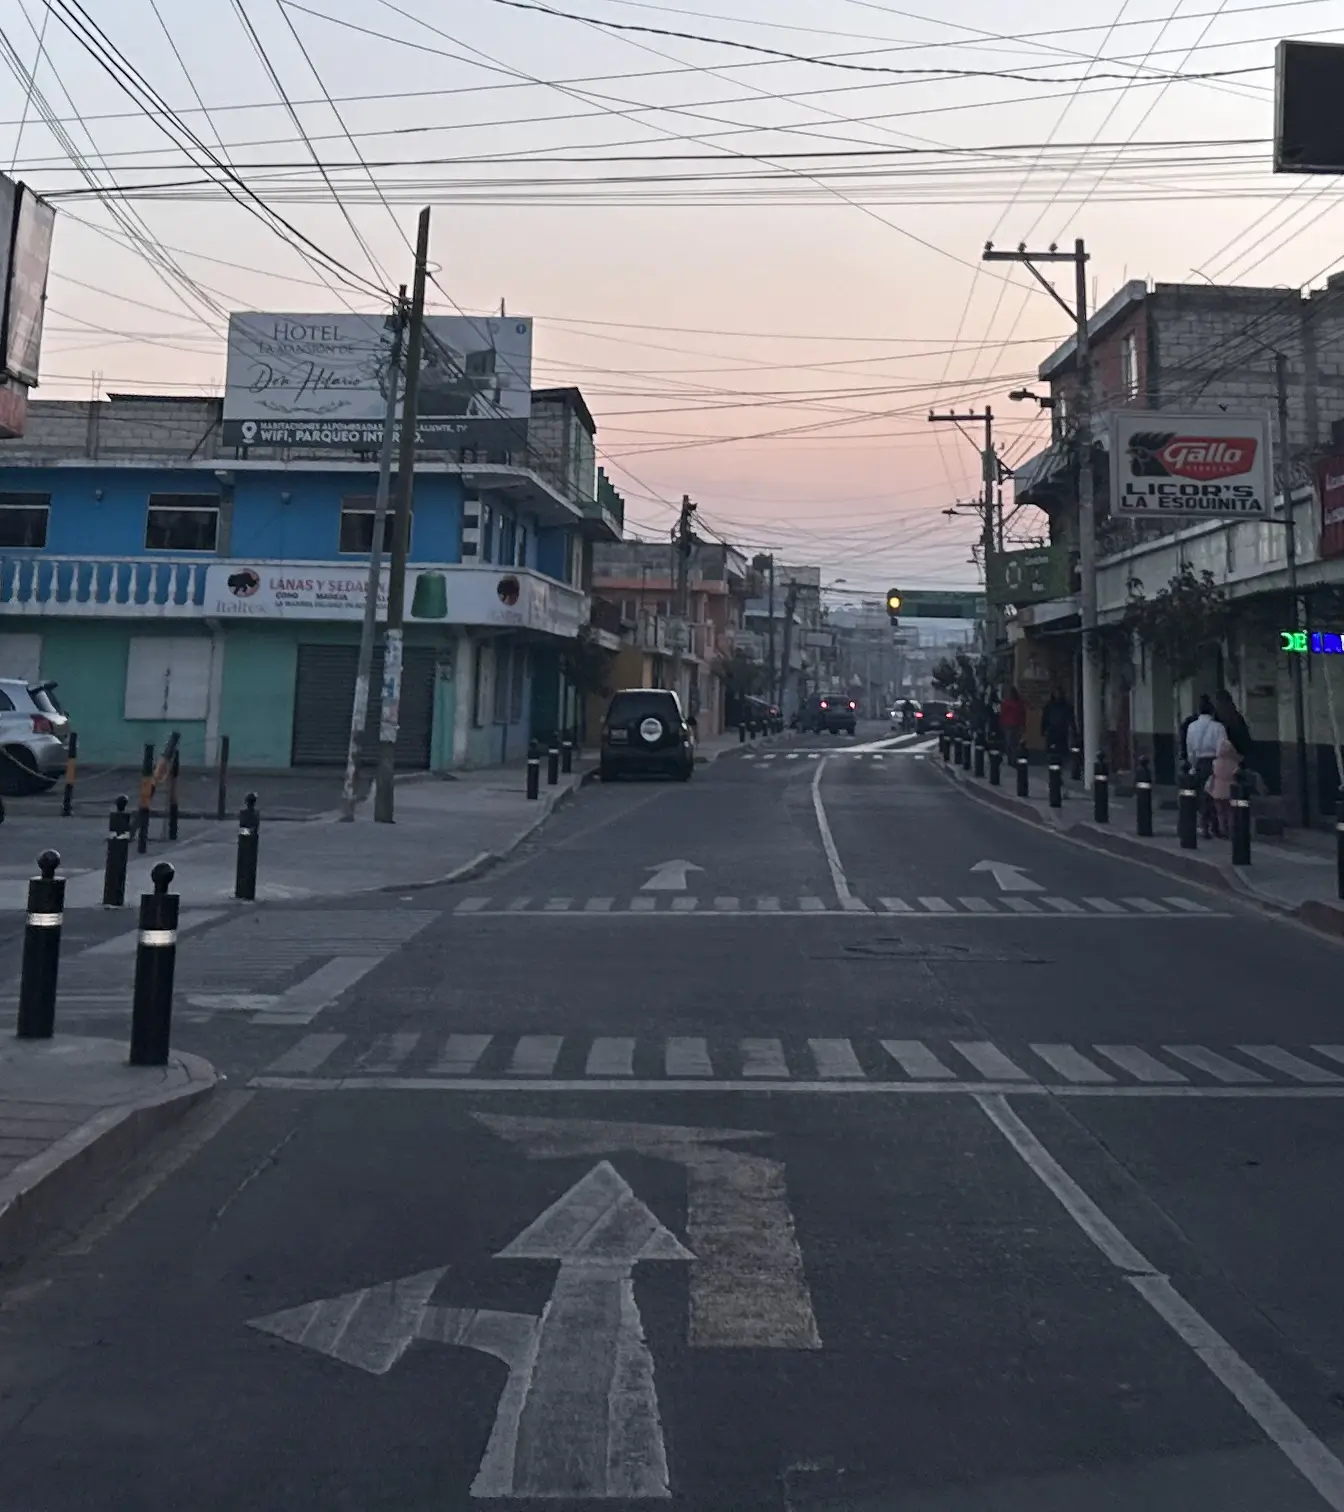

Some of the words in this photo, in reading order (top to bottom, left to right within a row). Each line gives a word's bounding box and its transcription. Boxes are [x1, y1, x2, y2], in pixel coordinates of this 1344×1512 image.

[273, 322, 341, 341] HOTEL
[247, 362, 290, 393] Don
[296, 430, 360, 444] PARQUEO
[1163, 442, 1243, 469] Gallo
[1126, 483, 1254, 498] LICOR'S
[1121, 496, 1148, 508] LA
[1158, 497, 1263, 511] ESQUINITA
[269, 577, 314, 591] LANAS
[316, 579, 326, 591] Y
